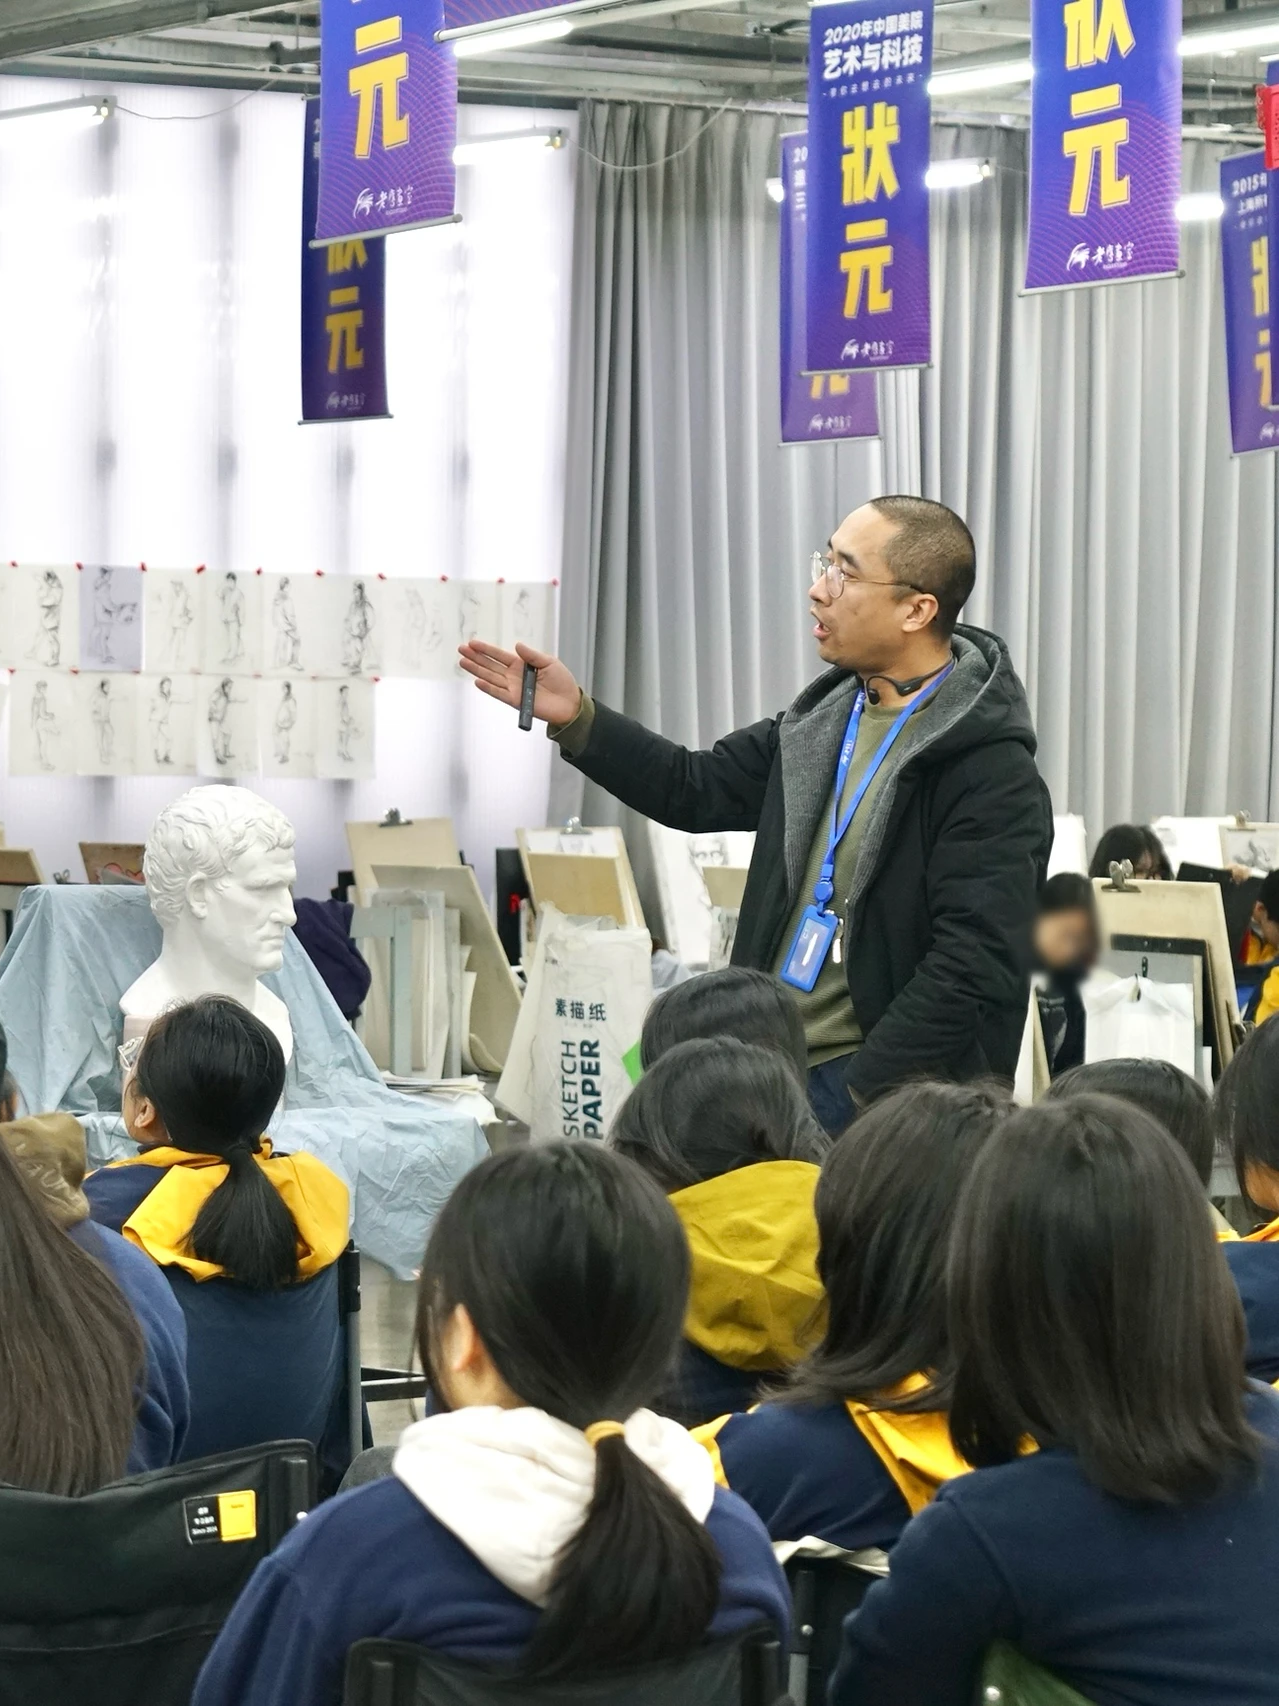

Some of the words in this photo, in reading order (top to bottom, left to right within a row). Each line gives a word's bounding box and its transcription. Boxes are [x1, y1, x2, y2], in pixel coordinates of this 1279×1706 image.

[823, 33, 924, 79] 艺术与科技
[554, 998, 607, 1022] 素描纸
[561, 1040, 580, 1139] SKETCH
[579, 1039, 604, 1140] PAPER
